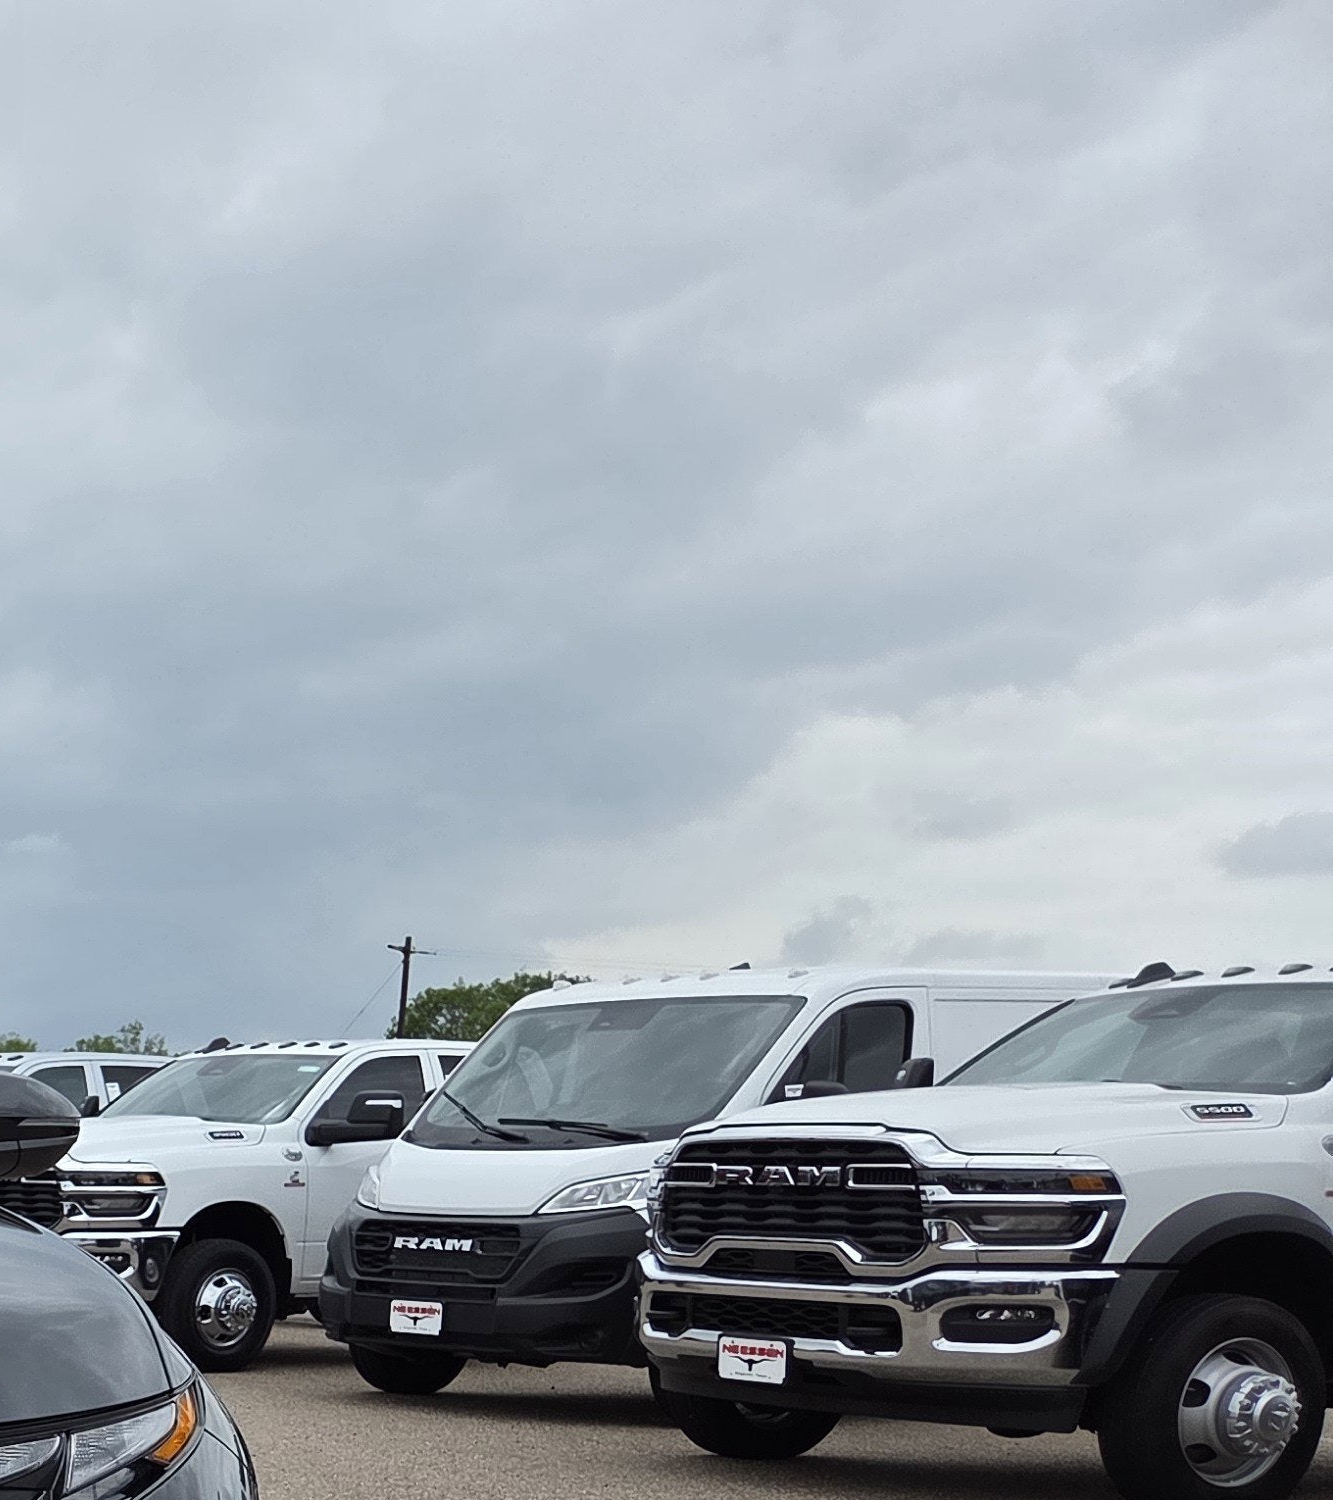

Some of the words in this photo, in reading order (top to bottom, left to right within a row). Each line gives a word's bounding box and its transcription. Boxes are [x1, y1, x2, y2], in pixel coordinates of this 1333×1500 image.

[1196, 1105, 1246, 1114] 5500
[716, 1165, 841, 1186] RAM
[393, 1236, 473, 1251] RAM
